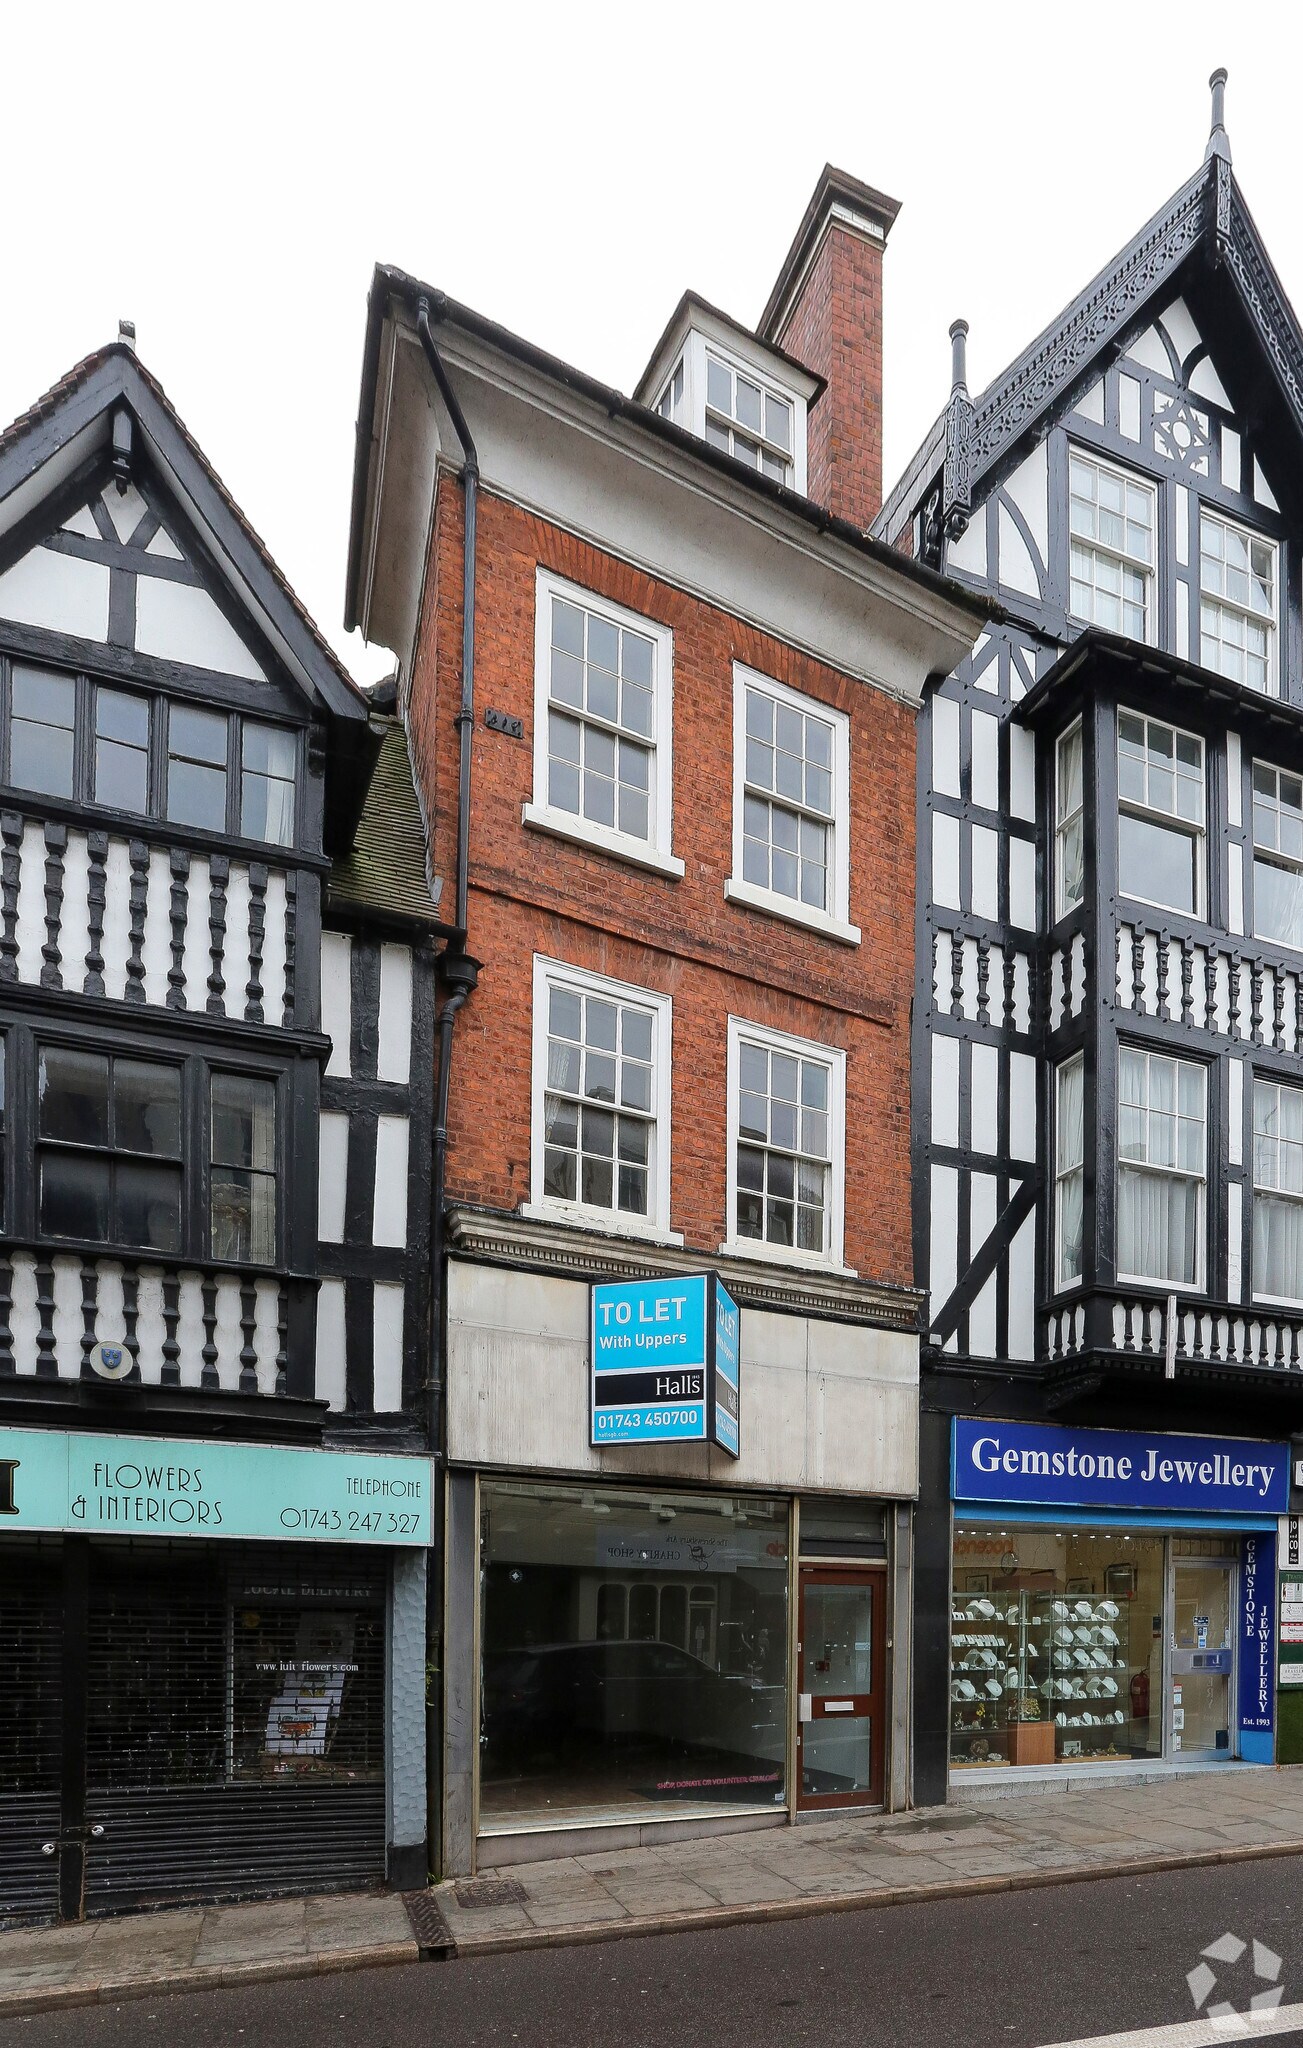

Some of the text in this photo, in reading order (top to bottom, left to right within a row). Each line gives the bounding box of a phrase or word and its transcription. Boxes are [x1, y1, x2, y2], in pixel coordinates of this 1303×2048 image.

[600, 1297, 687, 1326] TO LET
[600, 1332, 688, 1350] With Uppers
[655, 1375, 701, 1396] Halls
[598, 1413, 641, 1429] 01743
[644, 1410, 698, 1427] 450700
[93, 1463, 203, 1493] FLOWERS
[971, 1437, 1275, 1496] Gemstone Jewellery
[346, 1477, 422, 1498] TELEPHONE
[71, 1494, 224, 1525] & INTERIORS
[280, 1507, 420, 1534] 01743 247 327
[1245, 1540, 1256, 1637] GEMSTONE
[1258, 1605, 1270, 1713] JEWELLERY
[1243, 1717, 1270, 1727] Est. 1993
